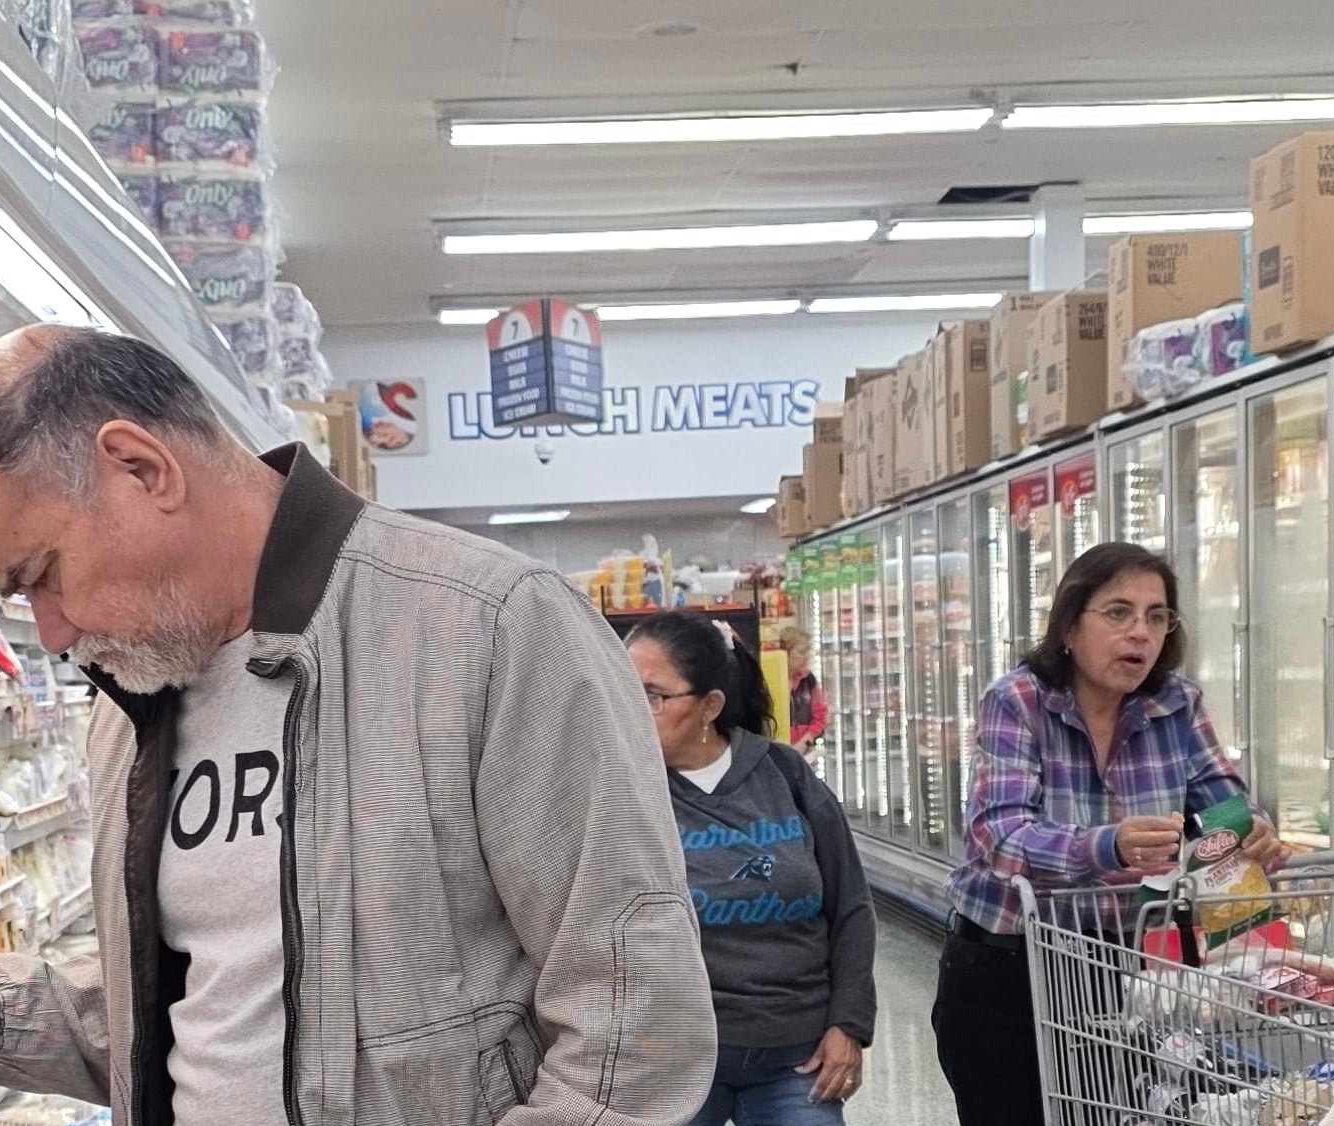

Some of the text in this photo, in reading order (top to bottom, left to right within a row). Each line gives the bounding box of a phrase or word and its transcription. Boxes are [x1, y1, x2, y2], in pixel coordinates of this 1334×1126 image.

[186, 105, 234, 129] Only
[186, 184, 234, 206] Only
[1147, 257, 1177, 271] WHITE
[1147, 272, 1177, 286] VALUE
[511, 320, 519, 340] 7
[571, 318, 579, 337] 7
[449, 381, 820, 440] LUH MEATS
[169, 750, 284, 851] OR
[680, 815, 806, 850] arolina
[1197, 832, 1236, 857] Chifles
